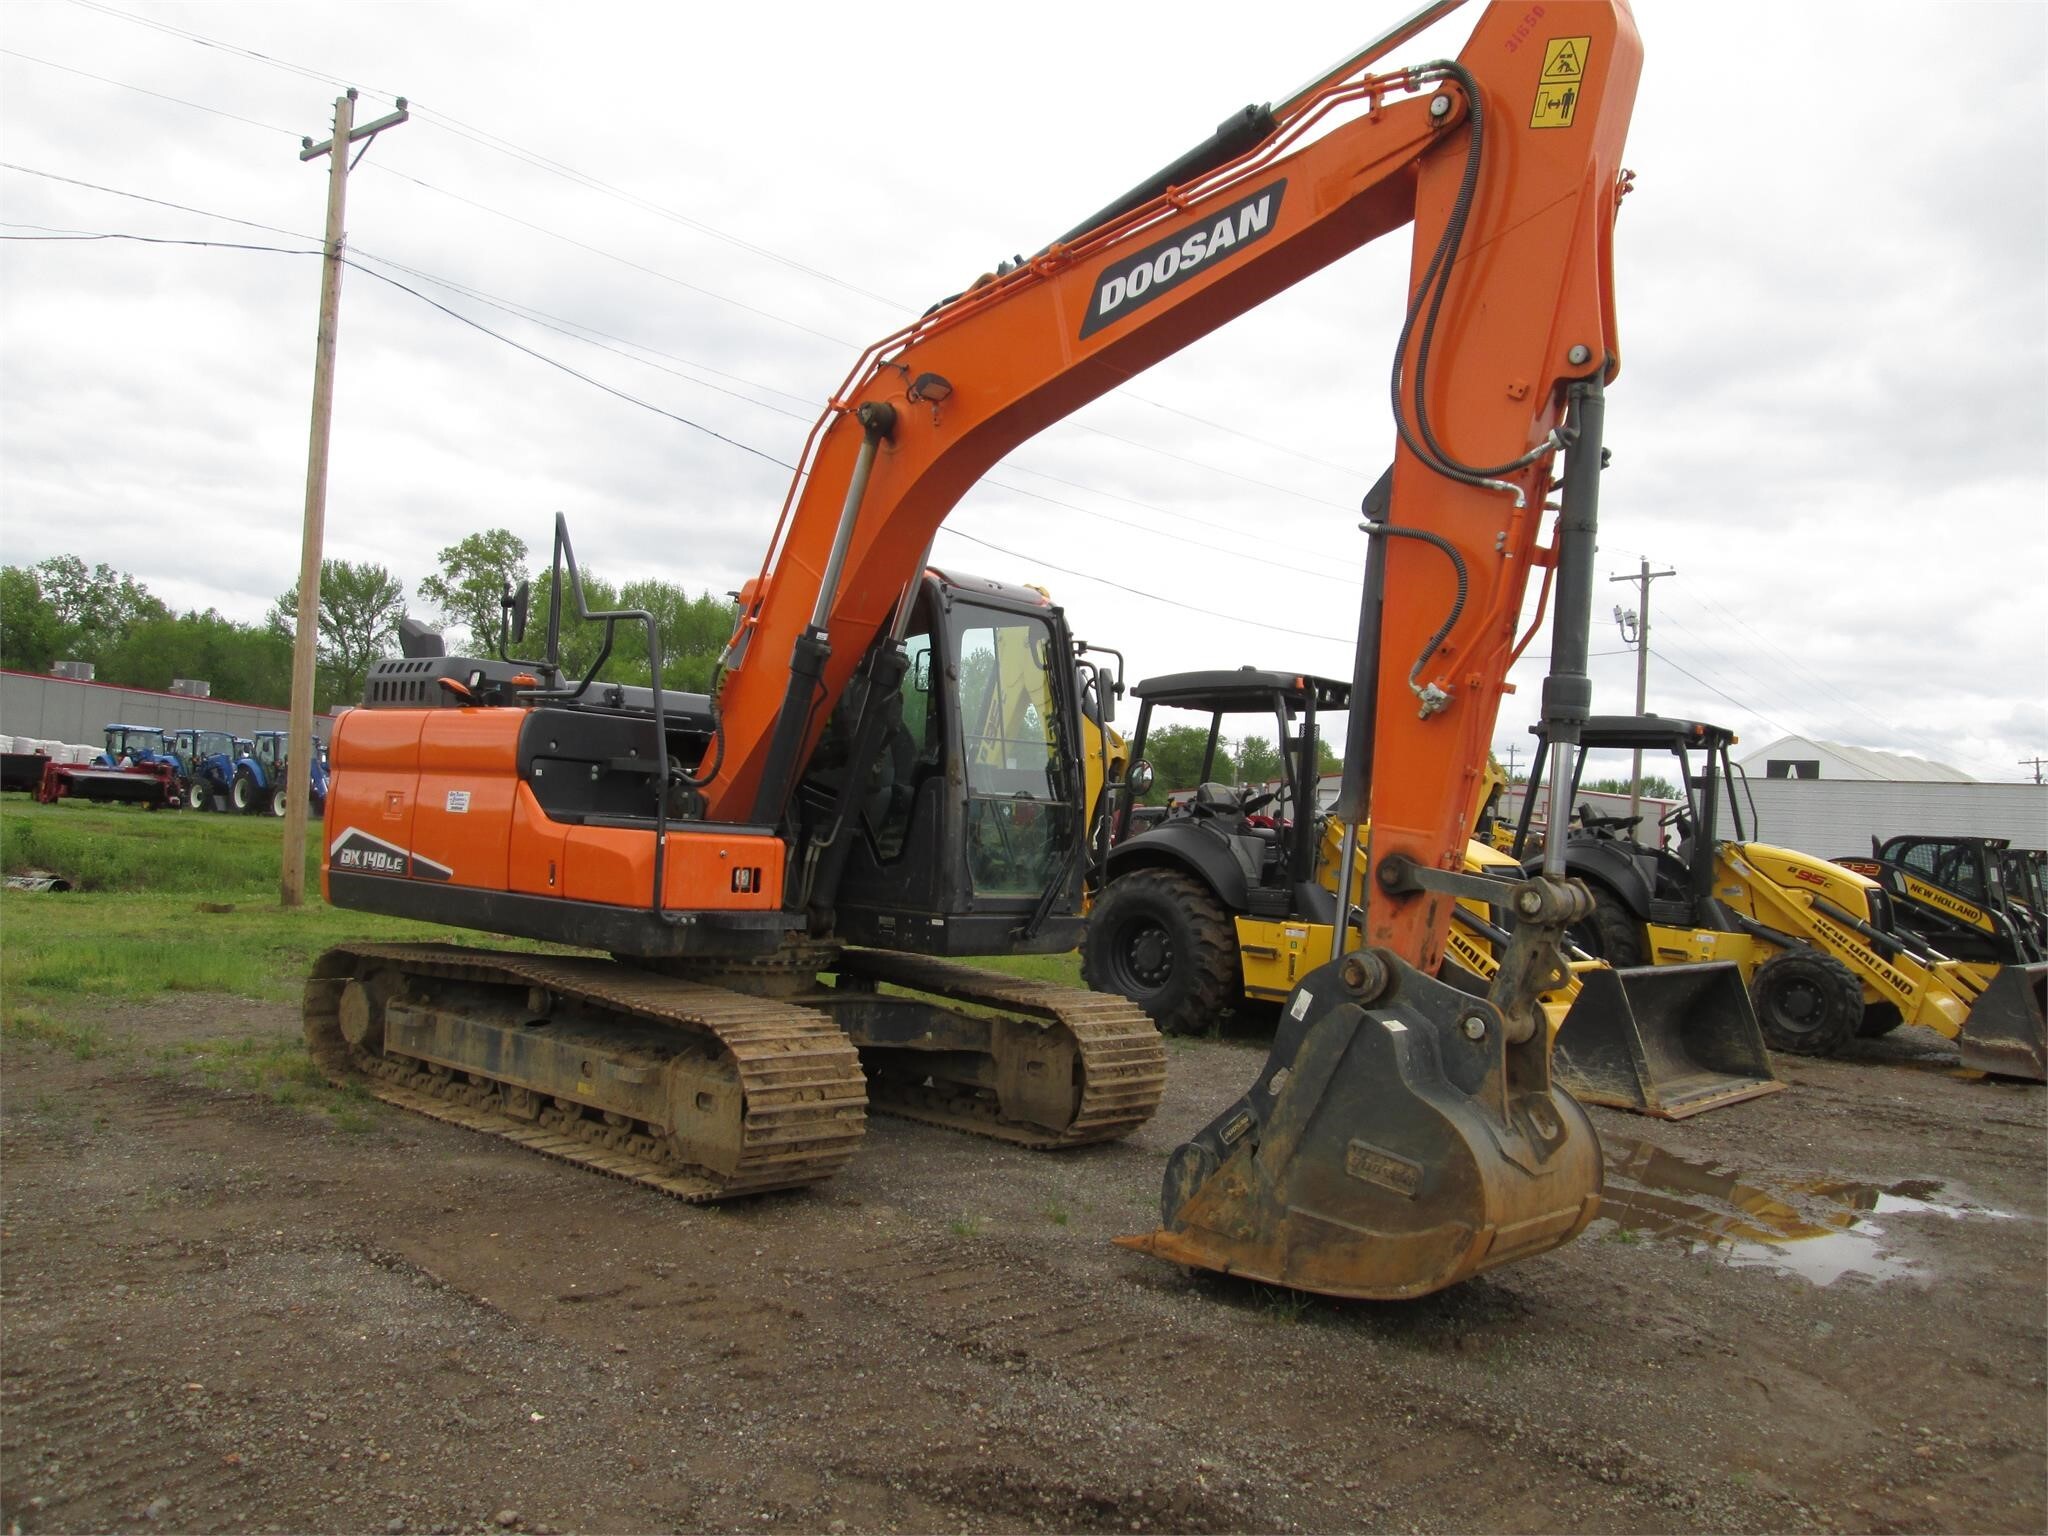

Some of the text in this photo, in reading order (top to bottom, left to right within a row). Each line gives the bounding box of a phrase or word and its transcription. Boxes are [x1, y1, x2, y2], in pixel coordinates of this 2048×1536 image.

[1099, 194, 1271, 316] DOOSAN
[1910, 883, 1978, 920] NEW HOLLAND
[1812, 919, 1914, 996] NEW HOLLAND
